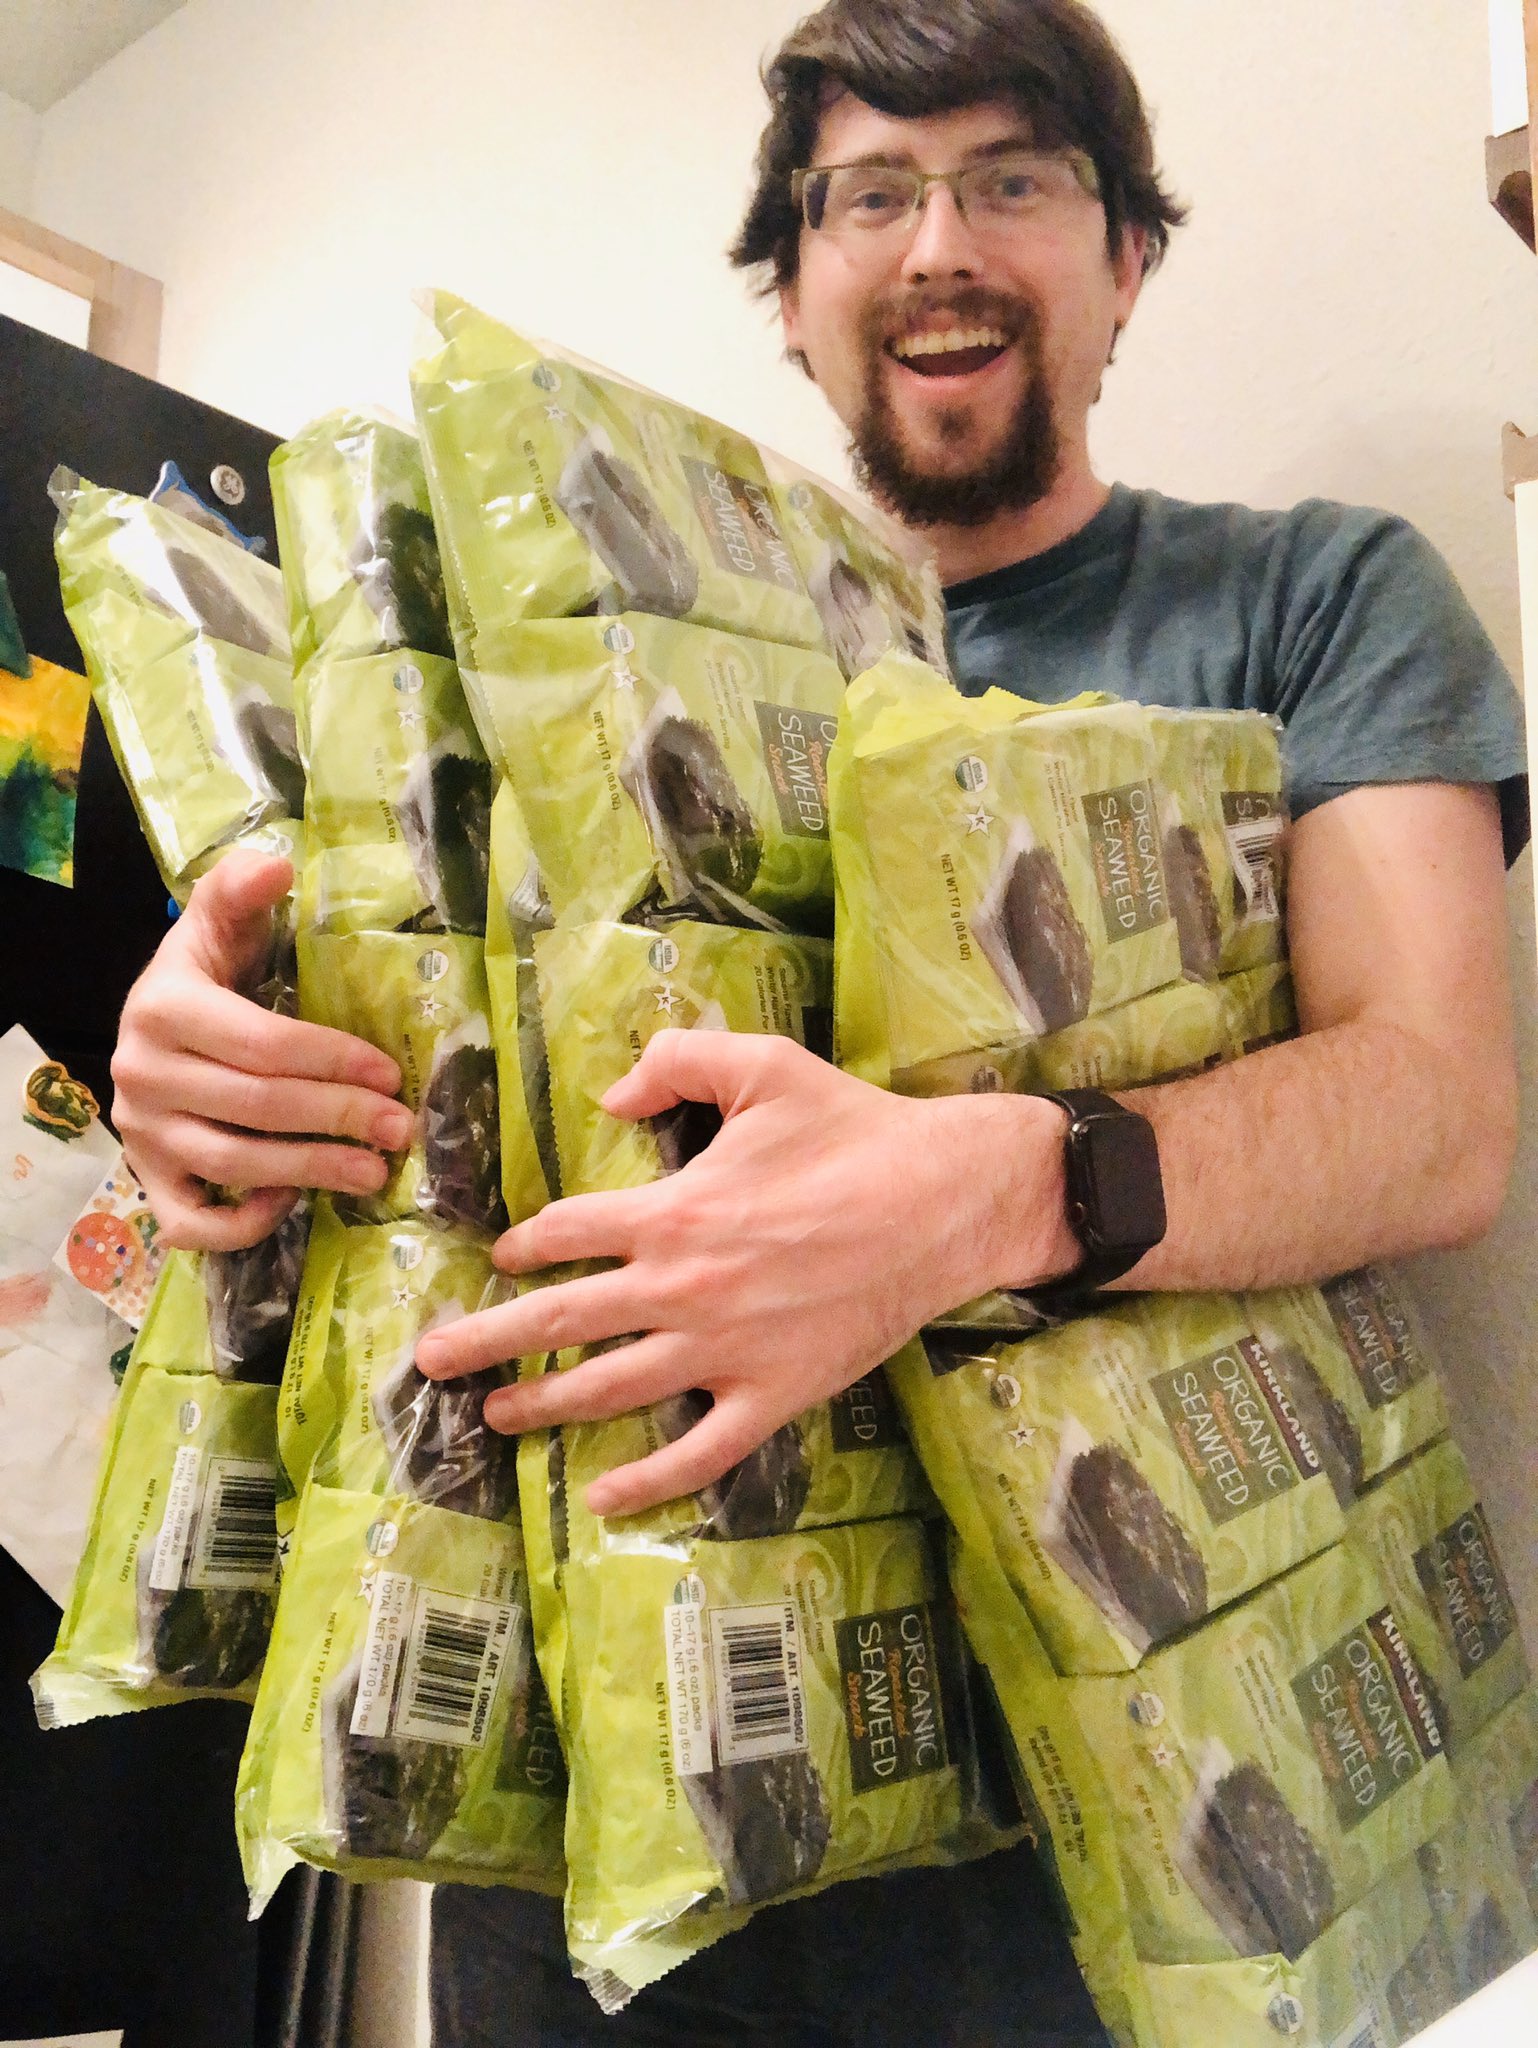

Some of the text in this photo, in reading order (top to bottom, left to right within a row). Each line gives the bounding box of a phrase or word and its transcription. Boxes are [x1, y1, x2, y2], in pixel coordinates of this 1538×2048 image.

[702, 467, 756, 571] SEAWEED
[778, 712, 825, 832] SEAWEED
[941, 853, 954, 874] NET
[1100, 797, 1138, 929] SEAWEED
[1129, 789, 1164, 919] ORGANIC
[945, 877, 959, 893] WT
[950, 897, 961, 909] 17
[952, 921, 968, 942] (0.6
[663, 945, 673, 966] USDA
[629, 1029, 642, 1049] NET
[300, 1333, 308, 1351] 170
[298, 1354, 305, 1369] WT
[293, 1395, 308, 1425] TOTAL
[1250, 1343, 1320, 1468] KIRKLAND
[1212, 1356, 1290, 1488] ORGANIC
[1172, 1372, 1249, 1506] SEAWEED
[149, 1479, 157, 1499] NET
[142, 1501, 152, 1517] WT
[380, 1578, 395, 1612] TOTAL
[326, 1611, 337, 1634] NET
[374, 1616, 388, 1641] NET
[494, 1610, 510, 1638] ITM.
[671, 1611, 683, 1650] TOTAL
[323, 1637, 333, 1656] WT
[370, 1644, 382, 1663] WT
[318, 1660, 329, 1672] 17
[484, 1651, 500, 1681] ART.
[674, 1654, 685, 1676] NET
[684, 1610, 697, 1646] 10-17
[692, 1695, 702, 1732] packs
[786, 1651, 799, 1681] ART.
[655, 1682, 665, 1705] NET
[676, 1679, 687, 1701] WT
[857, 1621, 897, 1777] SEAWEED
[900, 1613, 939, 1766] ORGANIC
[471, 1685, 493, 1743] 1098502
[658, 1710, 667, 1728] WT
[677, 1704, 689, 1726] 170
[1345, 1639, 1414, 1779] ORGANIC
[659, 1733, 668, 1745] 17
[1312, 1664, 1377, 1806] SEAWEED
[663, 1760, 674, 1787] (0.6
[665, 1788, 676, 1810] OZ)
